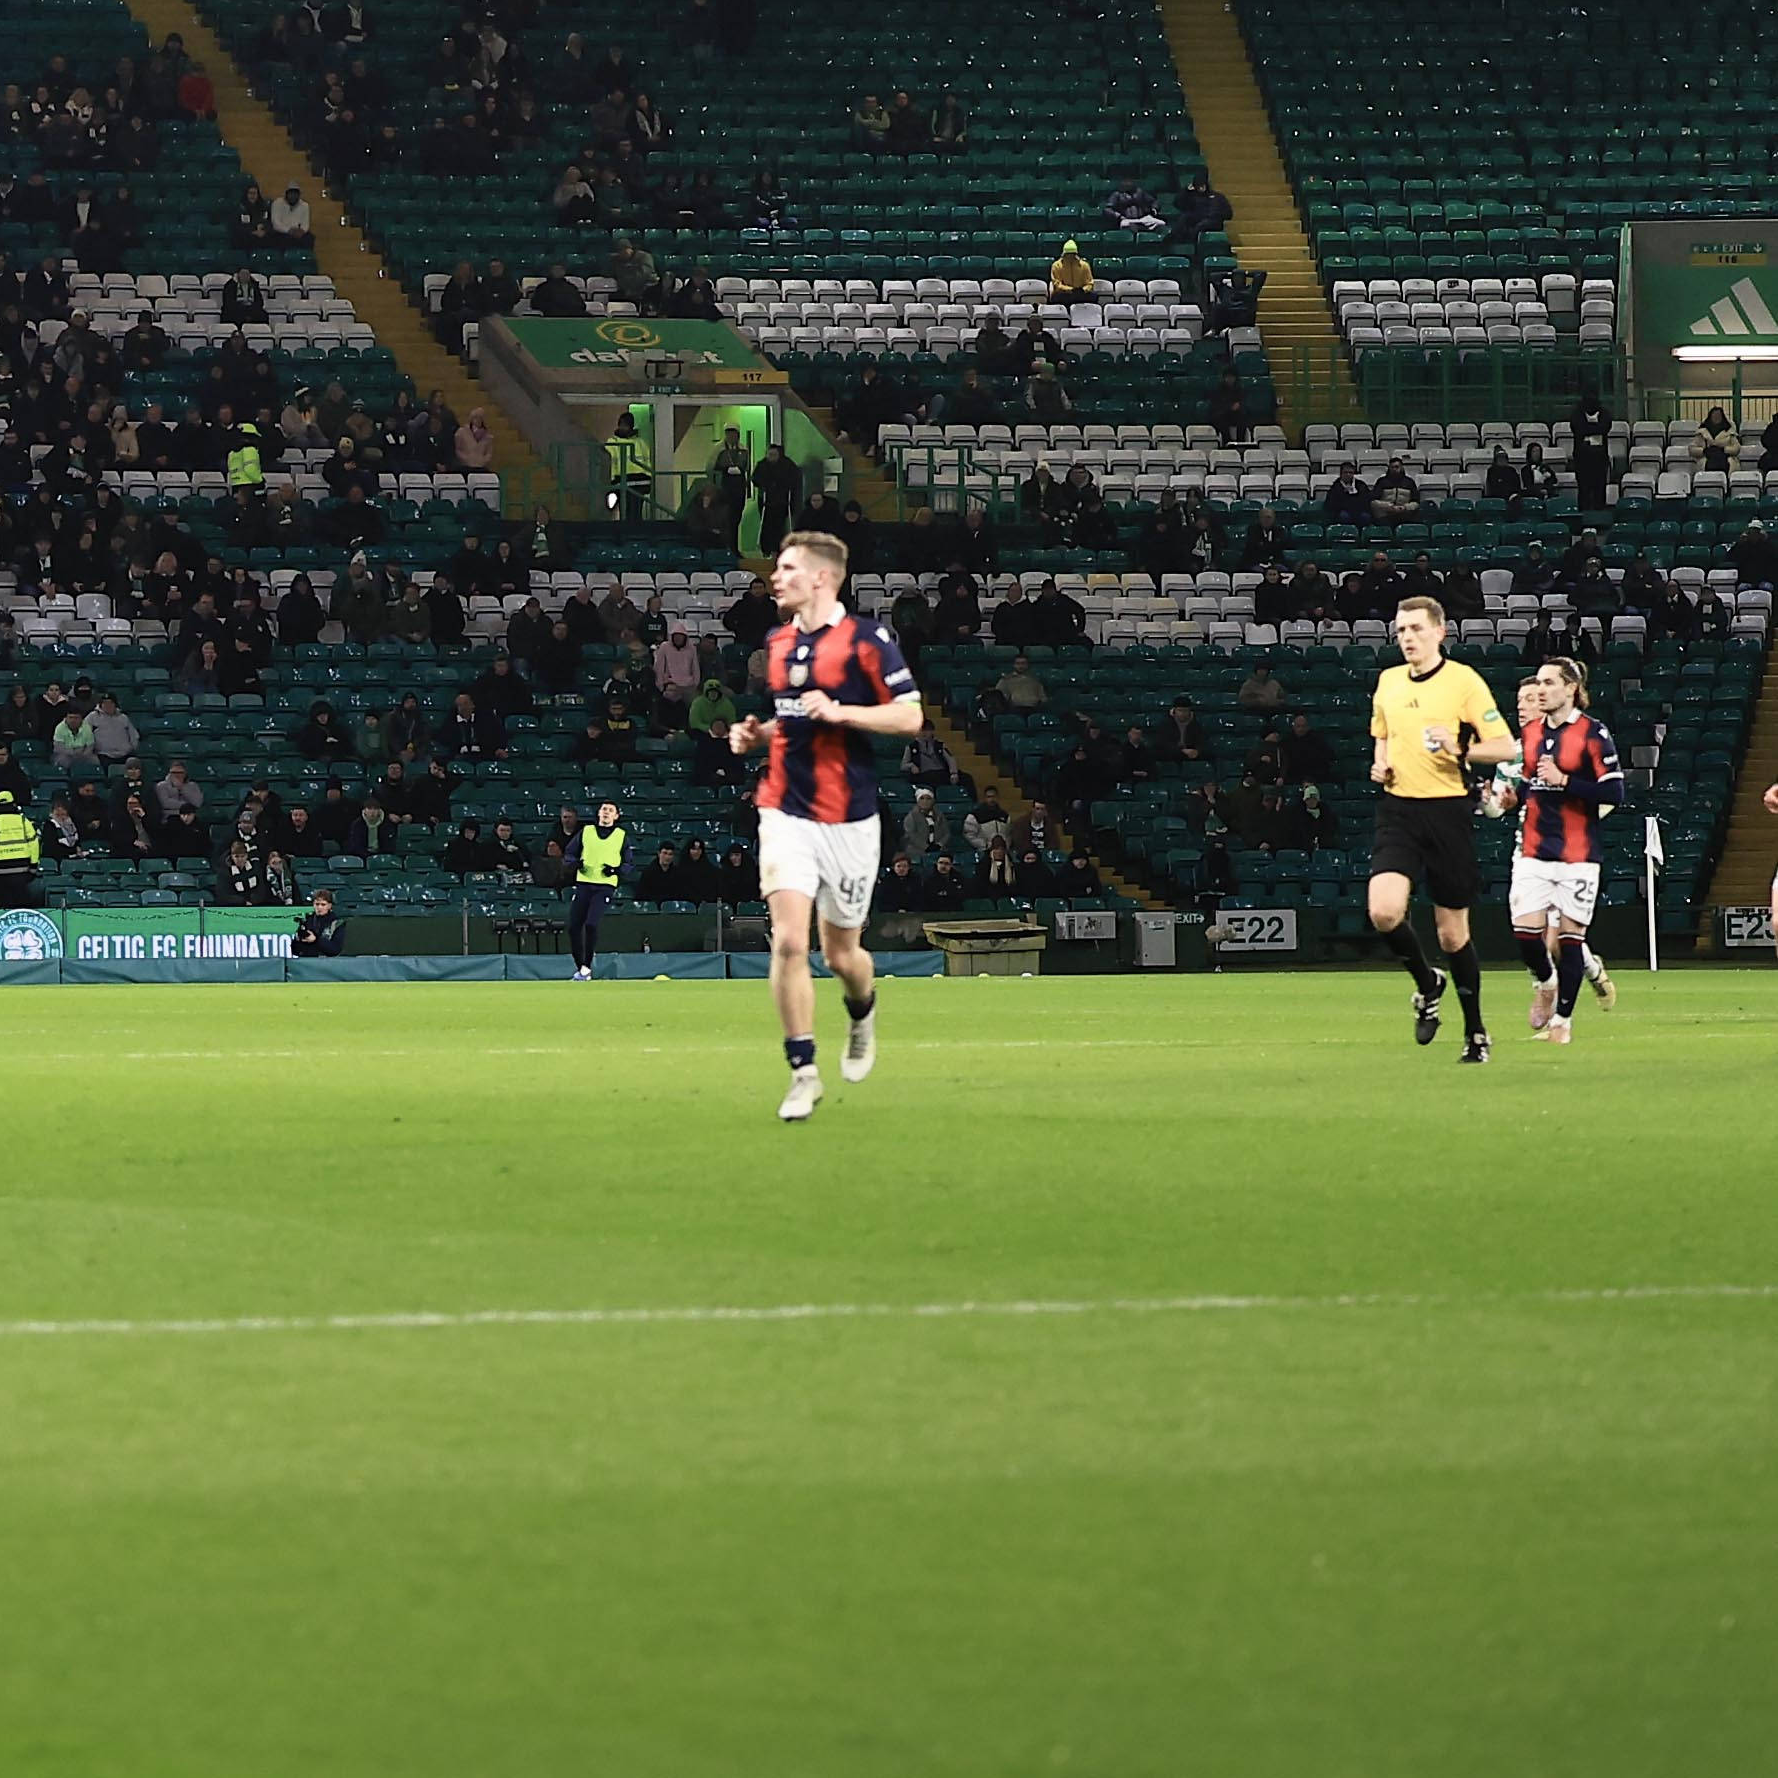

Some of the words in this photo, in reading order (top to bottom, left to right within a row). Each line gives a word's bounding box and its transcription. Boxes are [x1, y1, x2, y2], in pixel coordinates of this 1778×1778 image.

[570, 348, 724, 364] daft
[742, 373, 762, 382] 117
[1227, 915, 1285, 943] E22
[78, 935, 145, 959] CELTIC
[152, 934, 177, 959] FC
[183, 933, 300, 959] FOUNDATIO
